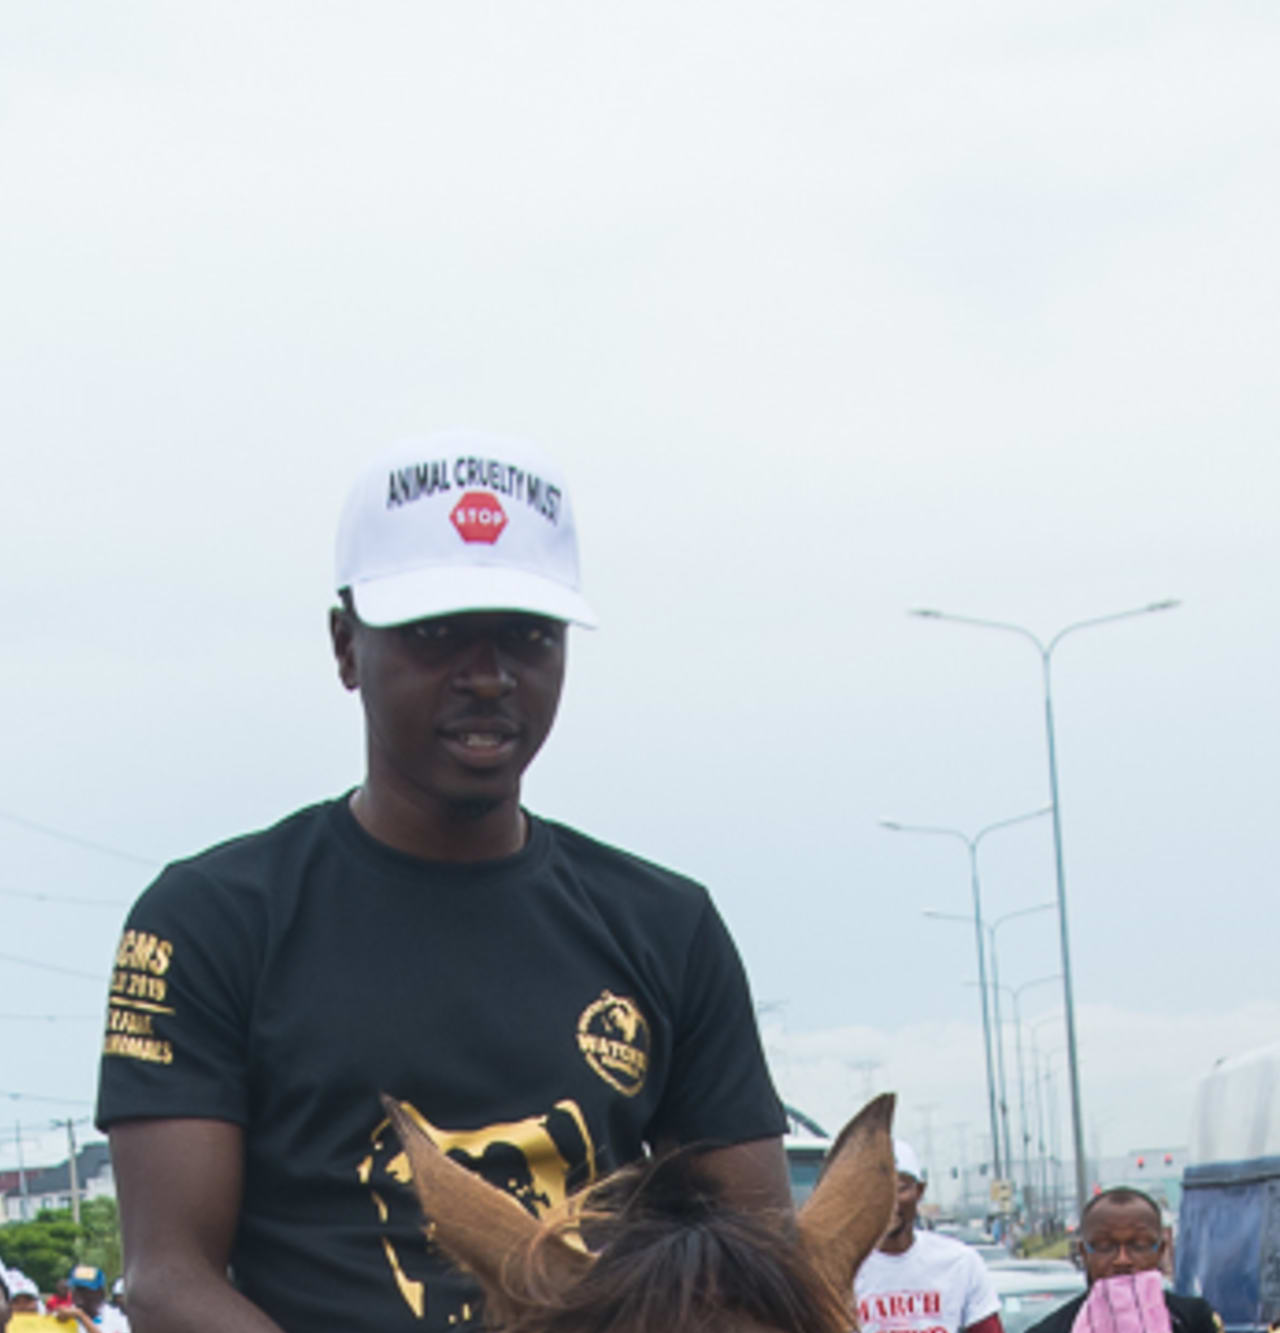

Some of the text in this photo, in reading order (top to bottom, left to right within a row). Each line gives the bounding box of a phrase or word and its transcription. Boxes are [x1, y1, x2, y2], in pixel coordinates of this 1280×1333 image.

[386, 456, 562, 526] ANIMAL CRUELTY MUST
[456, 508, 503, 526] STOP
